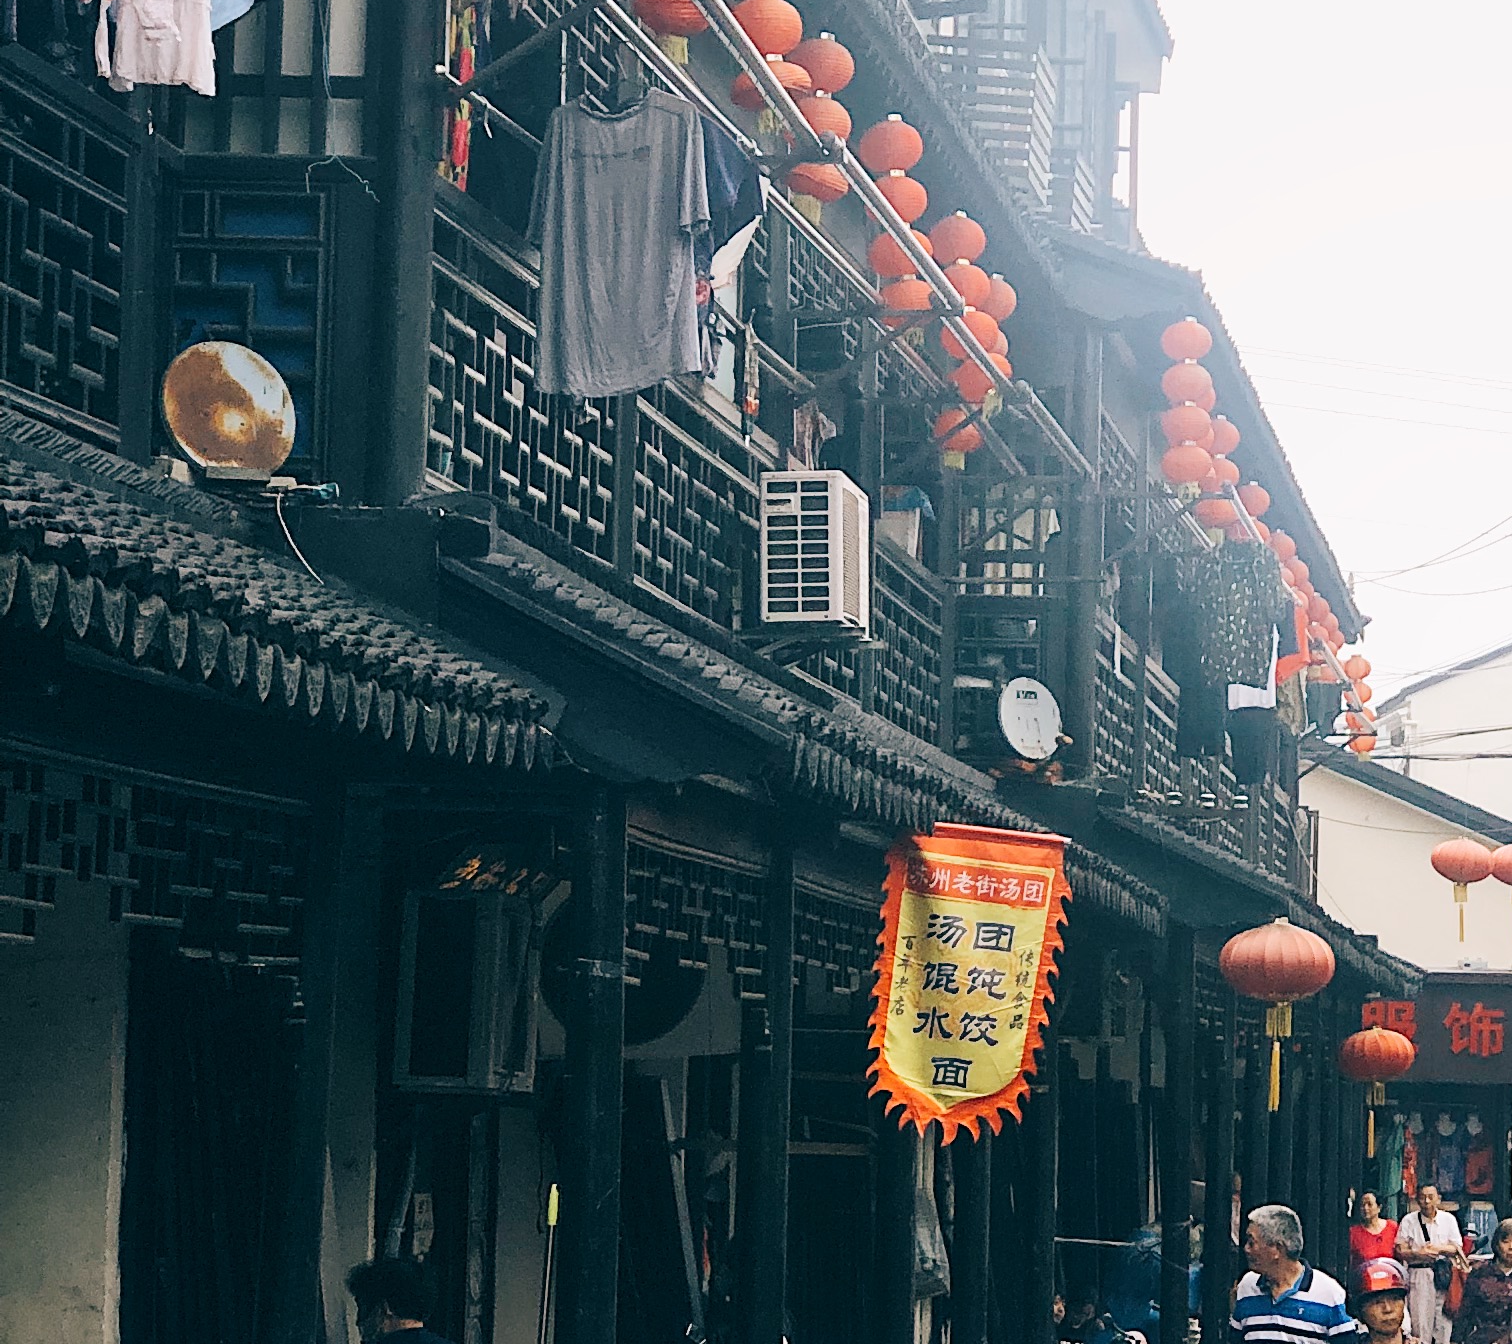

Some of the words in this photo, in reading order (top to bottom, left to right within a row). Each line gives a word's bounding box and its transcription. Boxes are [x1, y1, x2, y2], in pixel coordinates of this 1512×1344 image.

[927, 913, 1016, 953] 汤团
[922, 961, 1008, 1001] 馄饨
[912, 1007, 999, 1046] 水饺
[931, 1057, 972, 1089] 面
